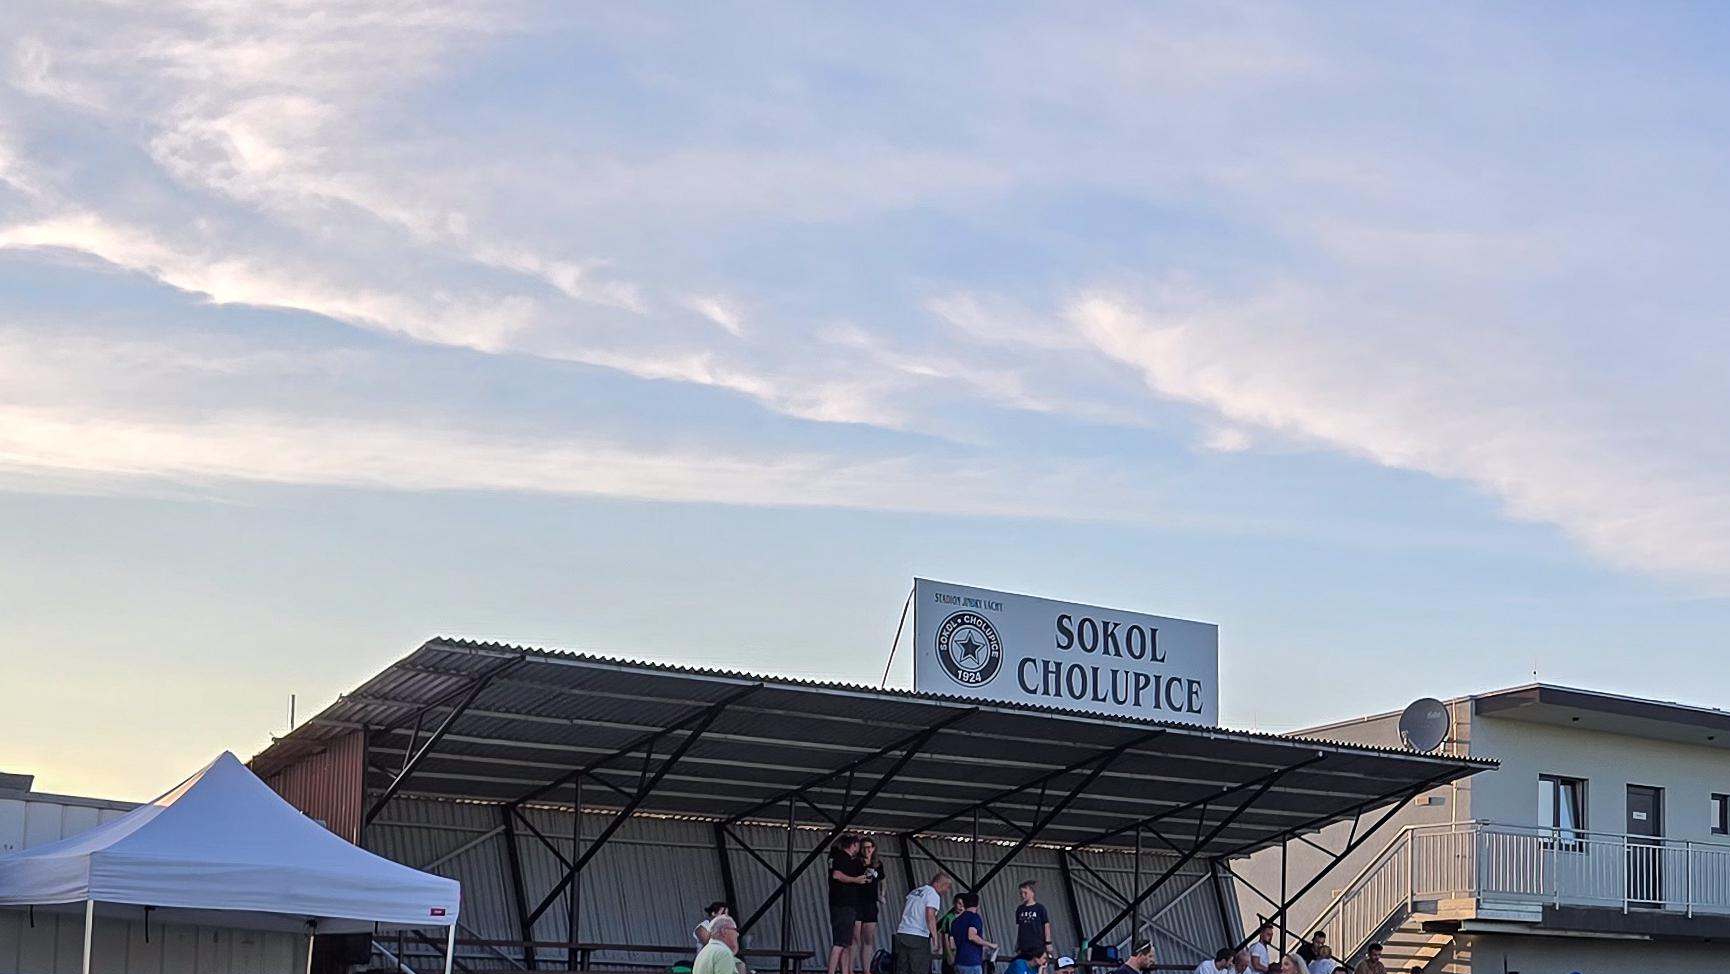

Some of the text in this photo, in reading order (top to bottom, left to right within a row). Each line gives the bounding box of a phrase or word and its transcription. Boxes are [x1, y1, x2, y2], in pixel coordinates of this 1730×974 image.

[934, 592, 961, 606] STADION
[940, 615, 999, 659] SOKOL CHOLUPICE
[1055, 613, 1167, 664] SOKOL
[957, 670, 982, 683] 1924
[1017, 657, 1204, 715] CHOLUPICE
